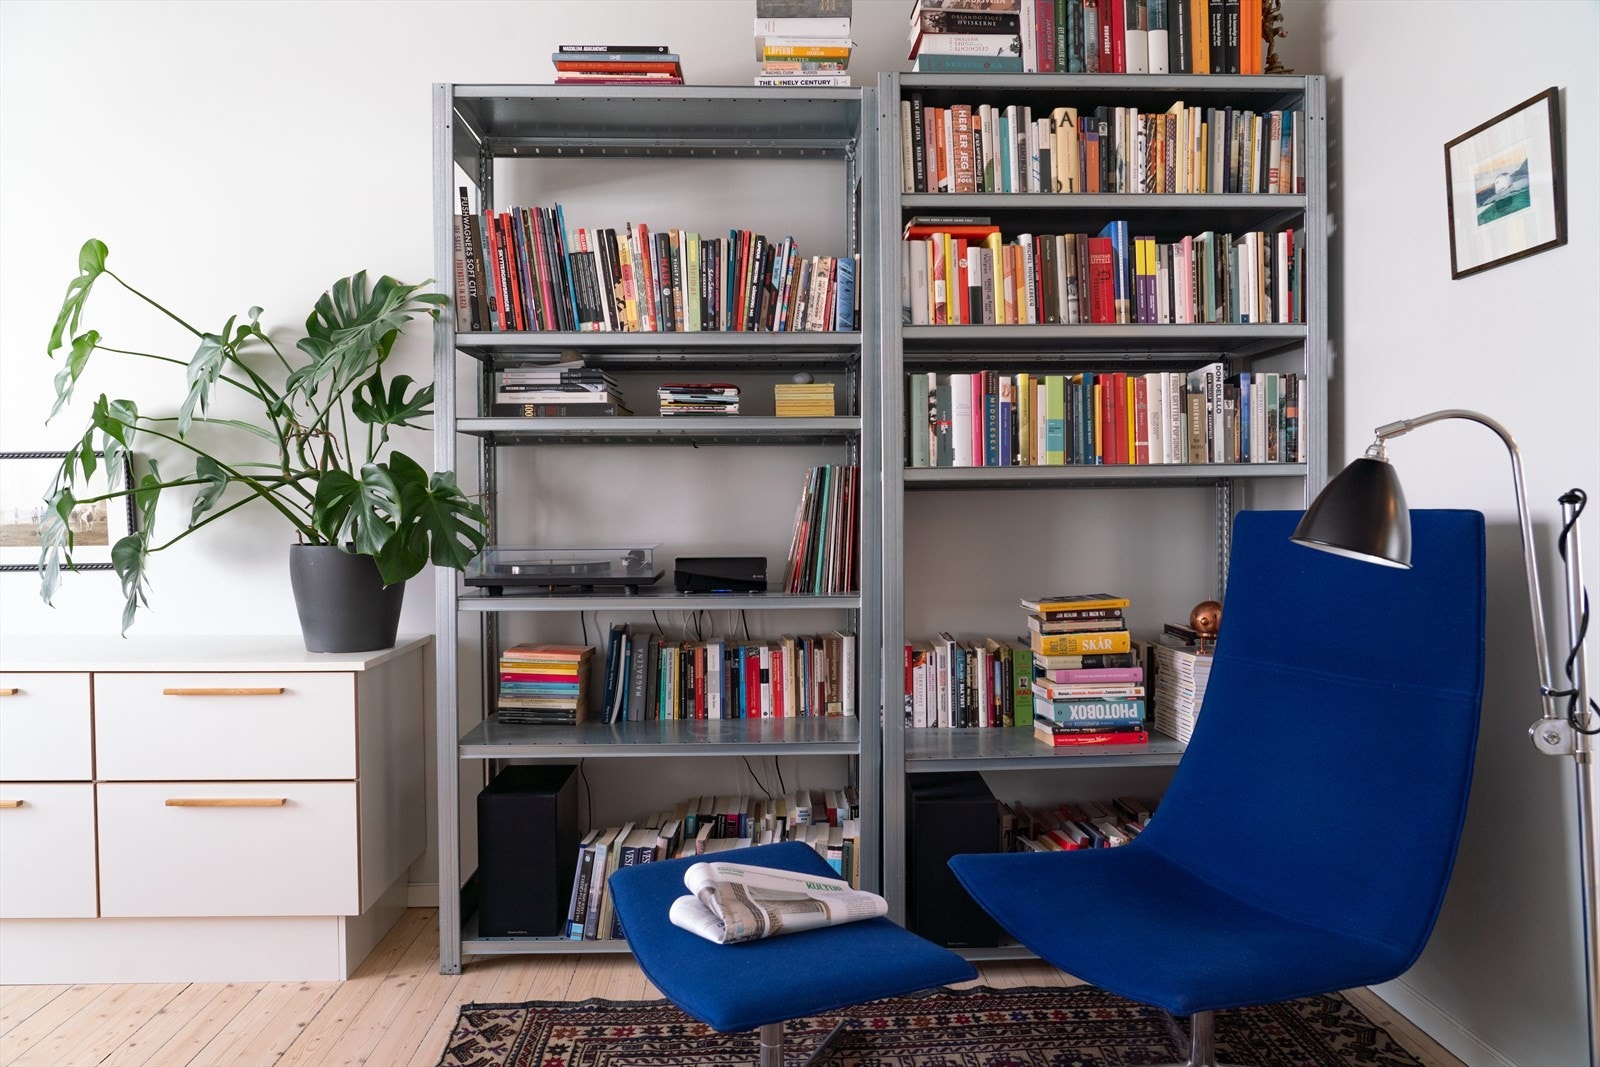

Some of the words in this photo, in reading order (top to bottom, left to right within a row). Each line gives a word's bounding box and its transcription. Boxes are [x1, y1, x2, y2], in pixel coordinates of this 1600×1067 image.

[959, 111, 967, 131] HER
[1059, 111, 1074, 127] A
[960, 135, 967, 148] ER
[461, 196, 473, 256] PUSHWAGNERS
[467, 259, 475, 278] SOFT
[457, 259, 465, 288] FOOTNOTES
[661, 258, 669, 286] MAUS
[498, 249, 510, 312] SKYTTERGRAVSKRIGEN
[1050, 641, 1058, 652] BRET
[1068, 639, 1077, 652] ELLIS
[1082, 636, 1112, 651] SKÅR
[1070, 703, 1138, 720] PHOTOBOX
[806, 882, 843, 892] KULTUR
